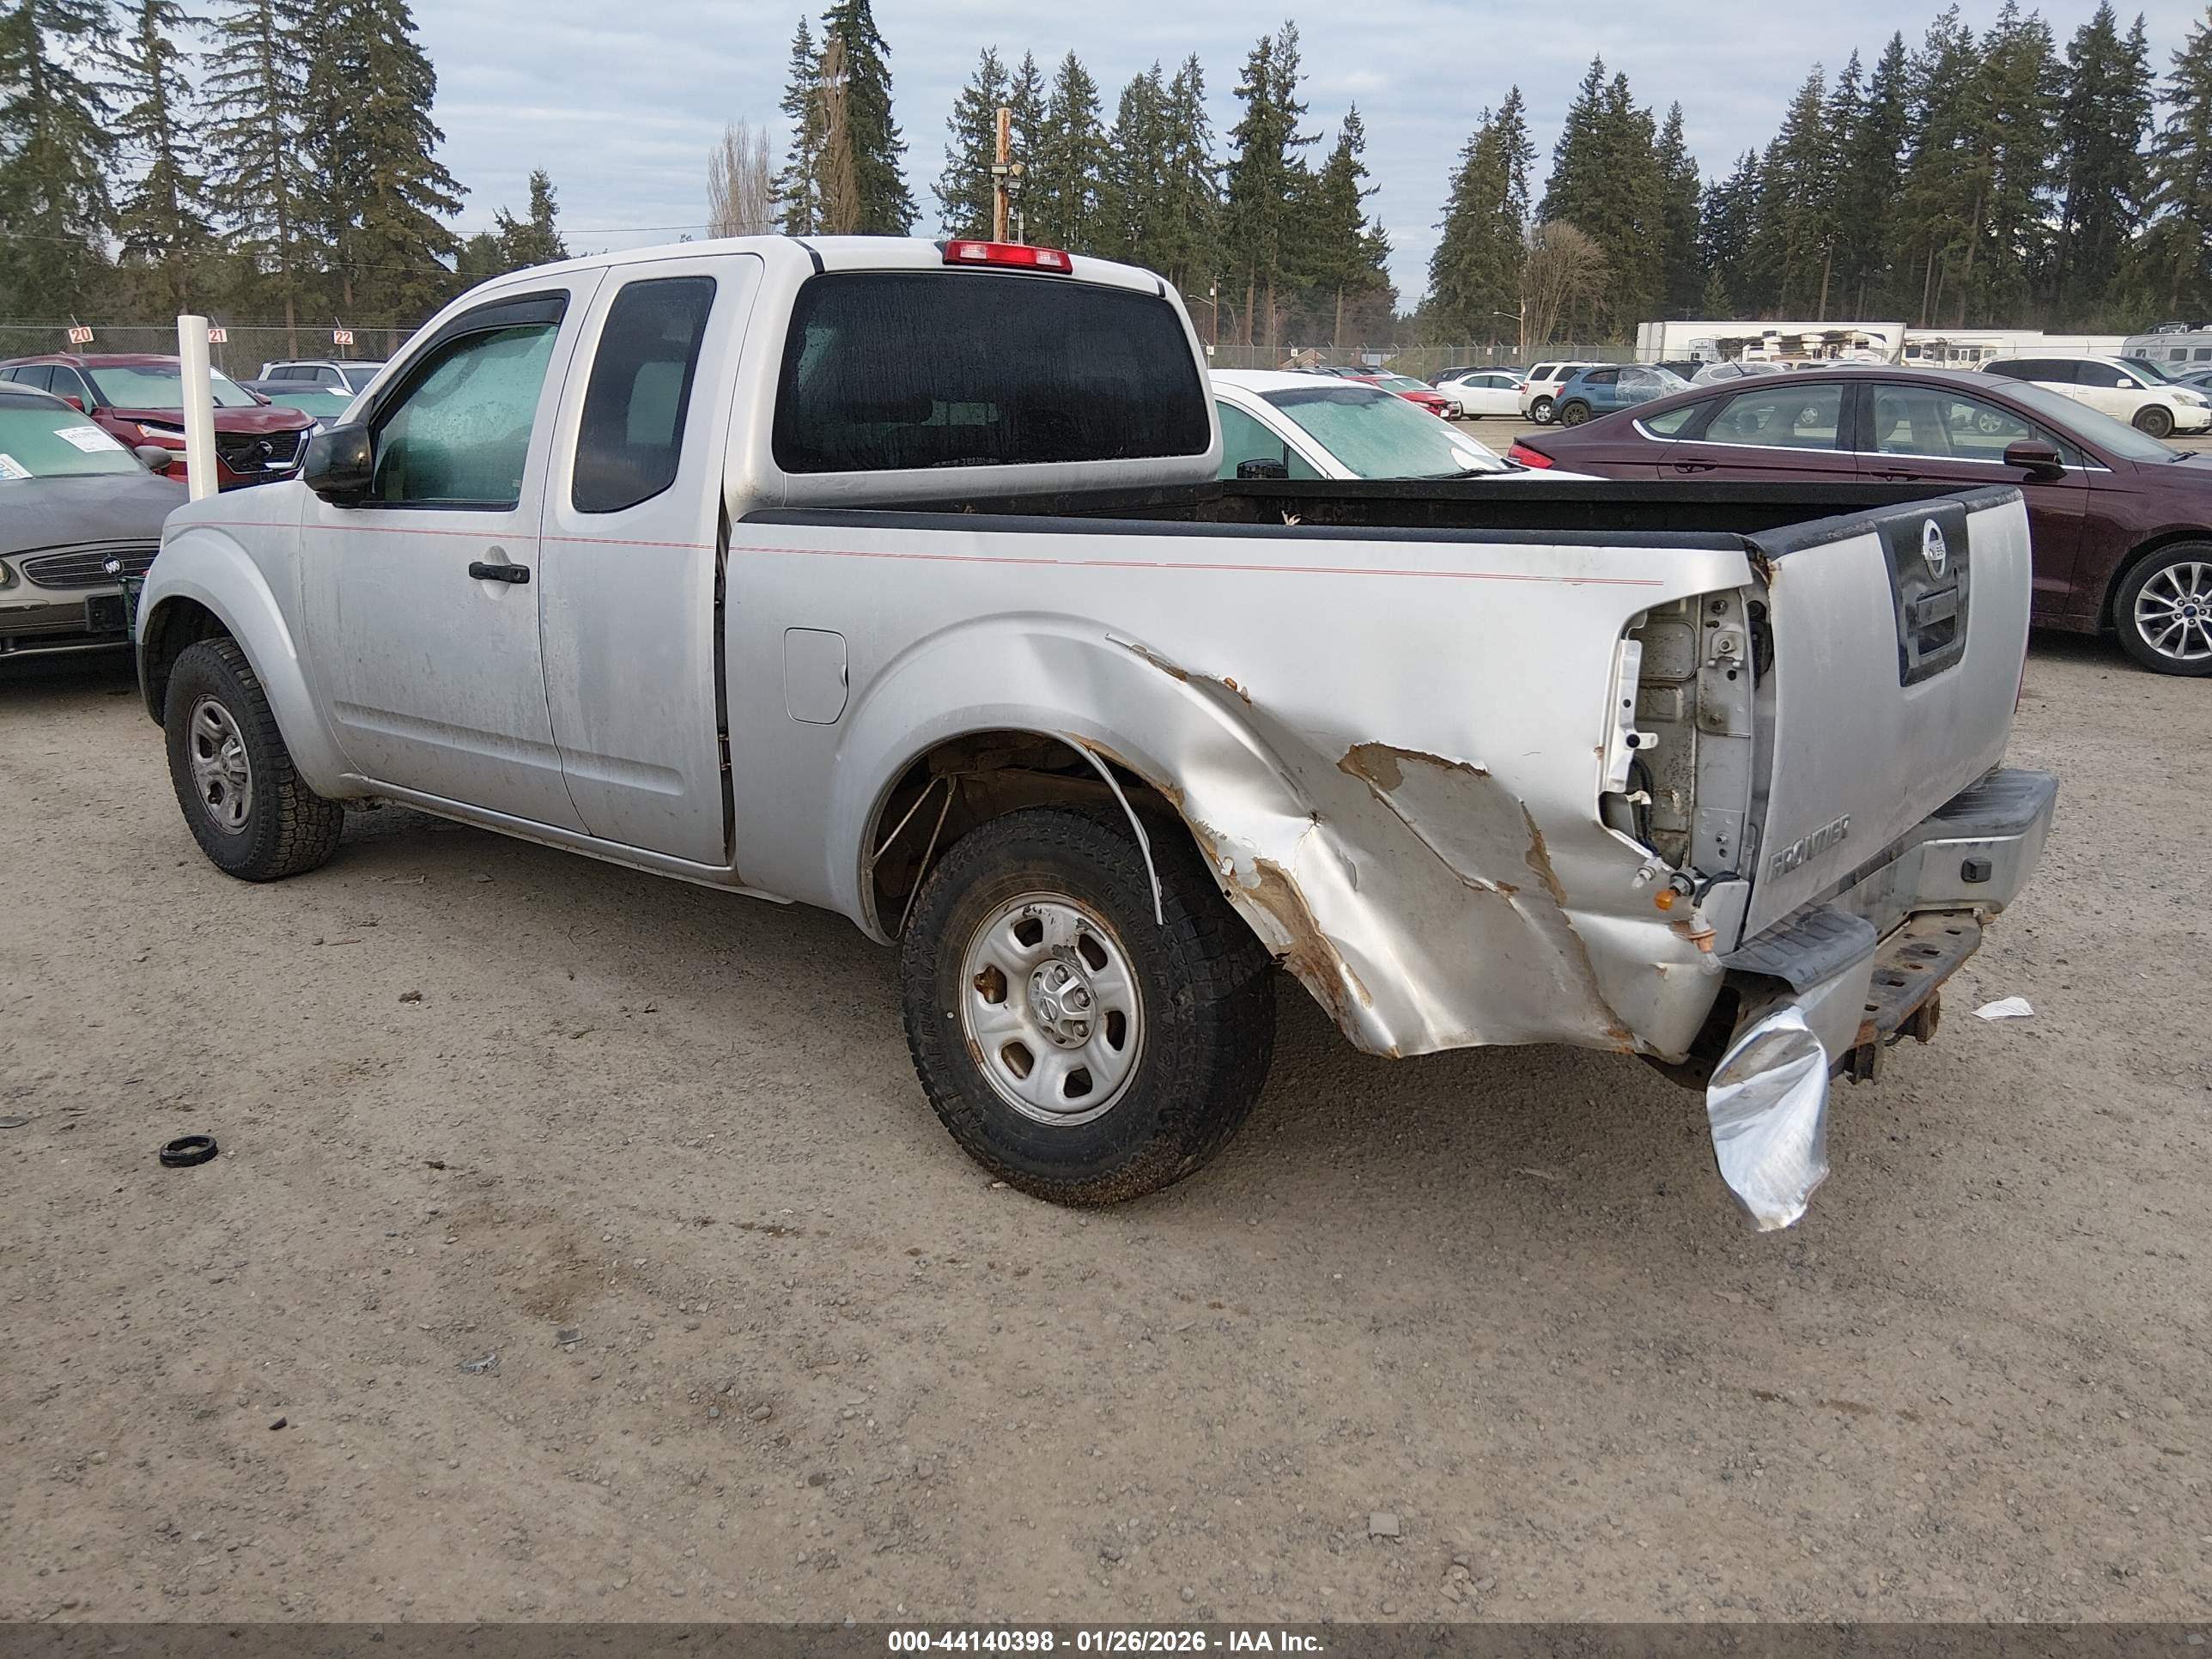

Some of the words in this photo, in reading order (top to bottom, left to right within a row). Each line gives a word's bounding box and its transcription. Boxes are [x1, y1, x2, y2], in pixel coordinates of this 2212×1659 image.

[71, 328, 91, 342] 20
[209, 329, 224, 342] 21
[335, 331, 351, 343] 22
[1764, 814, 1851, 884] FRONTIER
